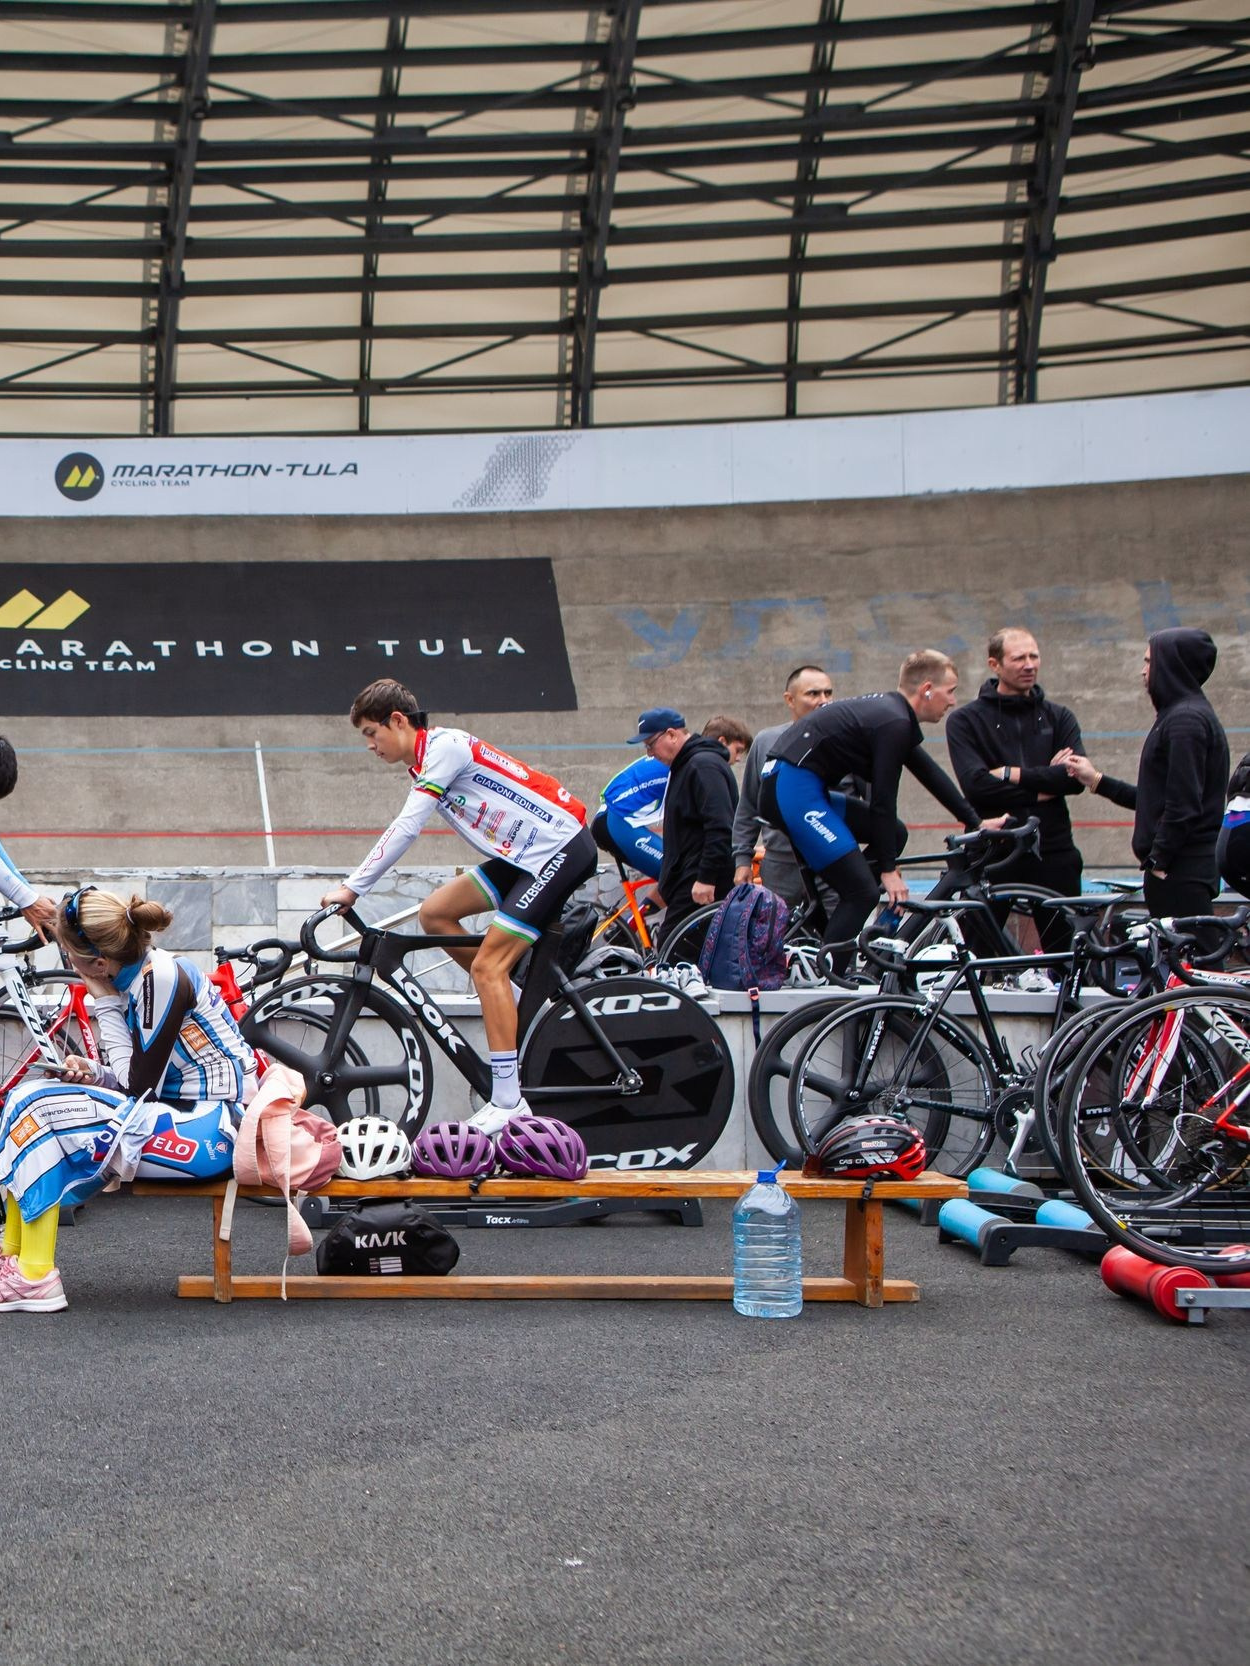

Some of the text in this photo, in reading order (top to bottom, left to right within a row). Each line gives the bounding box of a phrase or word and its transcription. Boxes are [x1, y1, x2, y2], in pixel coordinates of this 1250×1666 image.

[111, 479, 190, 488] CYCLING TEAM
[112, 462, 358, 478] MARATHON-TULA
[85, 660, 156, 671] TEAM
[475, 775, 514, 800] CIAPONI
[513, 795, 551, 822] EDILIZIA
[515, 851, 568, 910] UZBEKISTAN
[254, 982, 346, 1025] COX
[391, 967, 466, 1055] LOOK
[559, 991, 682, 1020] COX
[12, 980, 59, 1065] SCOTT
[402, 1027, 425, 1124] COX
[203, 1138, 218, 1162] Nalini
[587, 1142, 699, 1171] COX
[485, 1215, 512, 1225] Tacx
[355, 1230, 407, 1249] KASK
